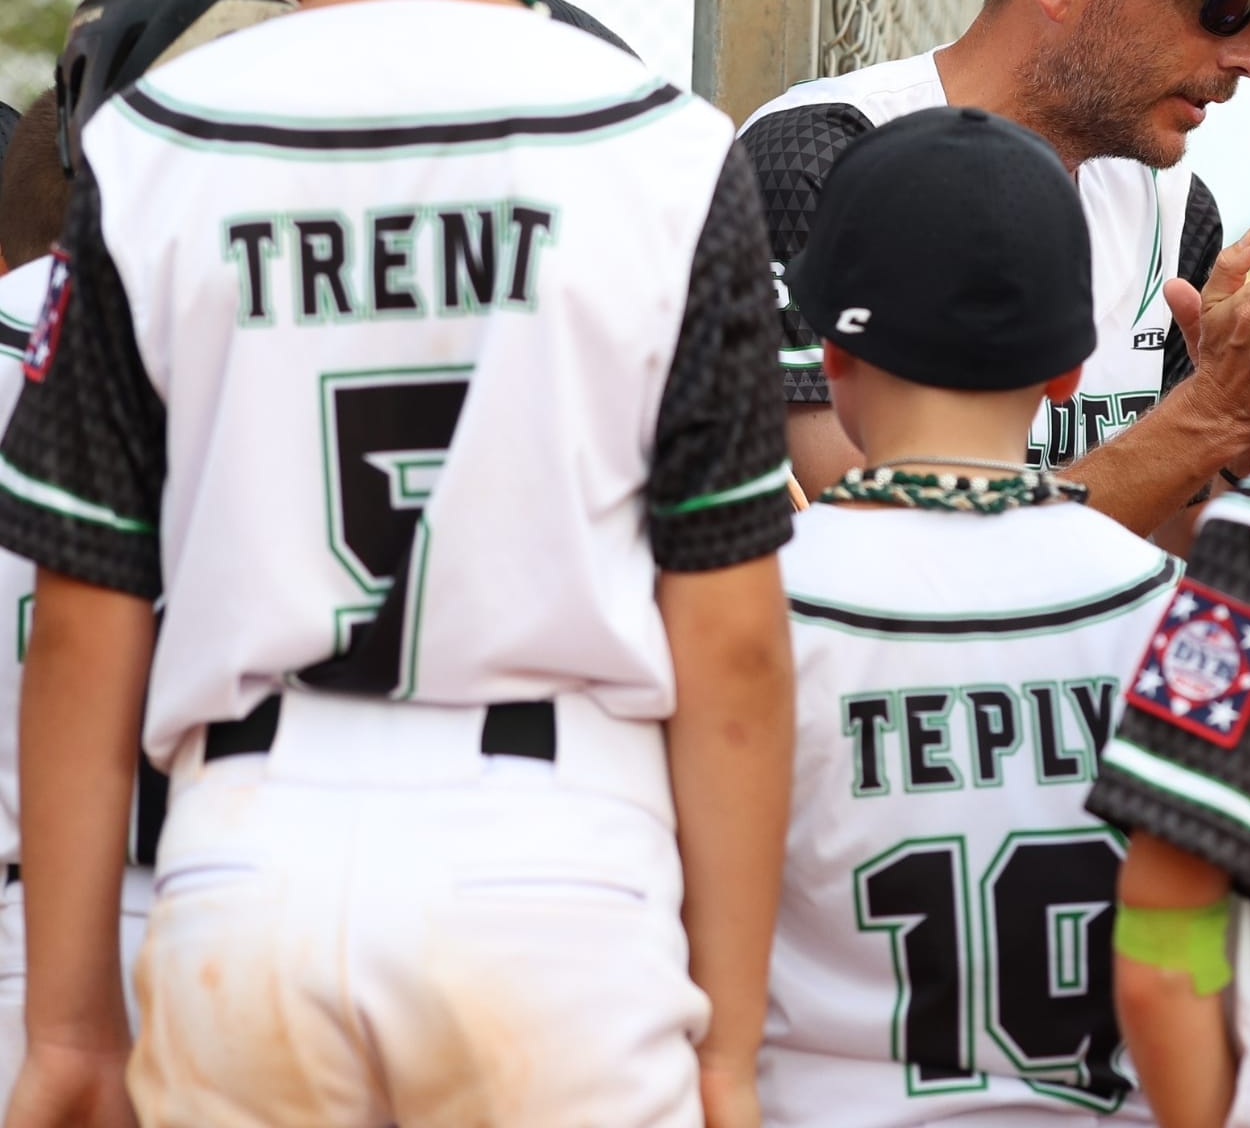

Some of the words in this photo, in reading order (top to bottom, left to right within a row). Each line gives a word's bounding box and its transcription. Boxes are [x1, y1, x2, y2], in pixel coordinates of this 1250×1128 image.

[222, 197, 561, 326] TRENT
[1133, 331, 1165, 349] PTS
[841, 676, 1121, 798] TEPLY
[853, 825, 1134, 1115] 19
